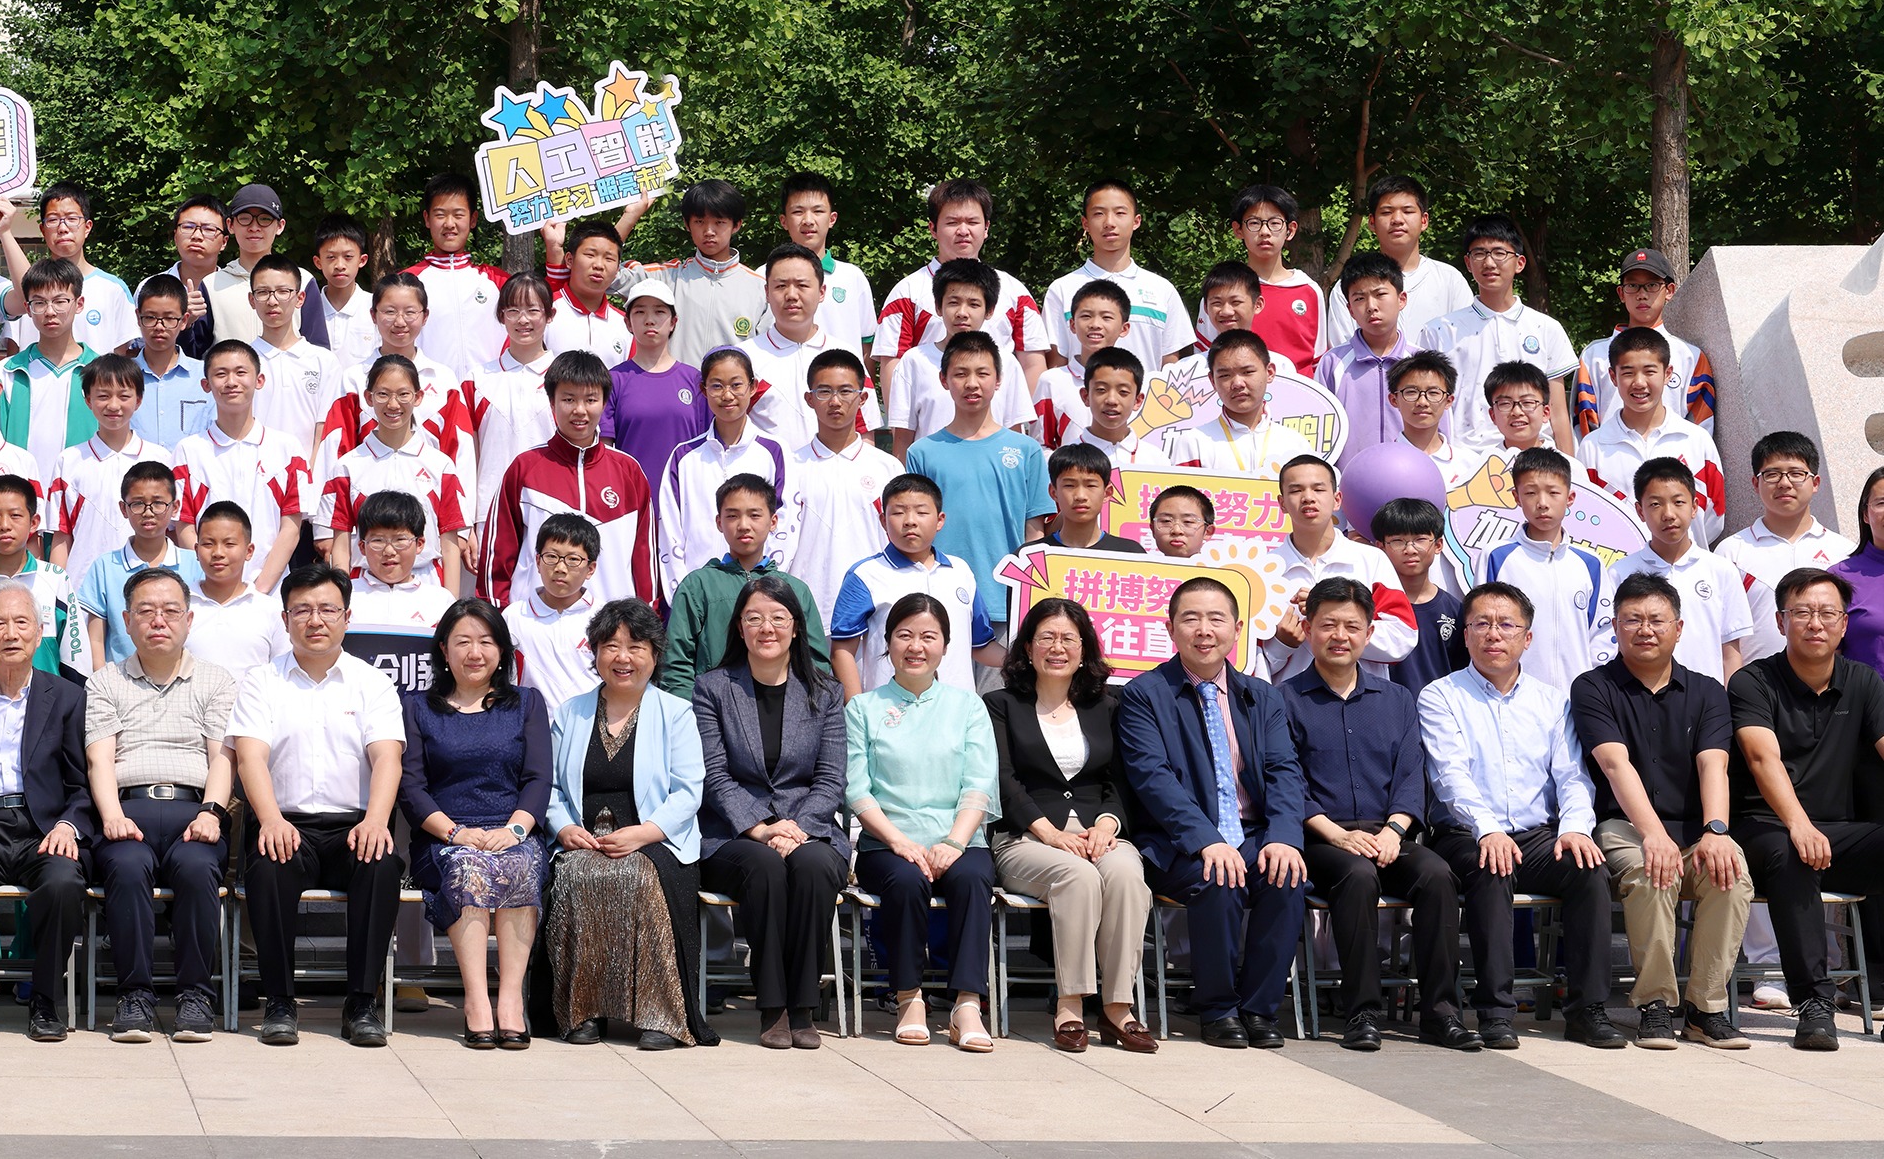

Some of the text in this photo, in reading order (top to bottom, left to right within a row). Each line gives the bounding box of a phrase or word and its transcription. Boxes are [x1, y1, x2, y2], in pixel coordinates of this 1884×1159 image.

[506, 121, 671, 196] 人工智能
[507, 182, 595, 228] 努力学习
